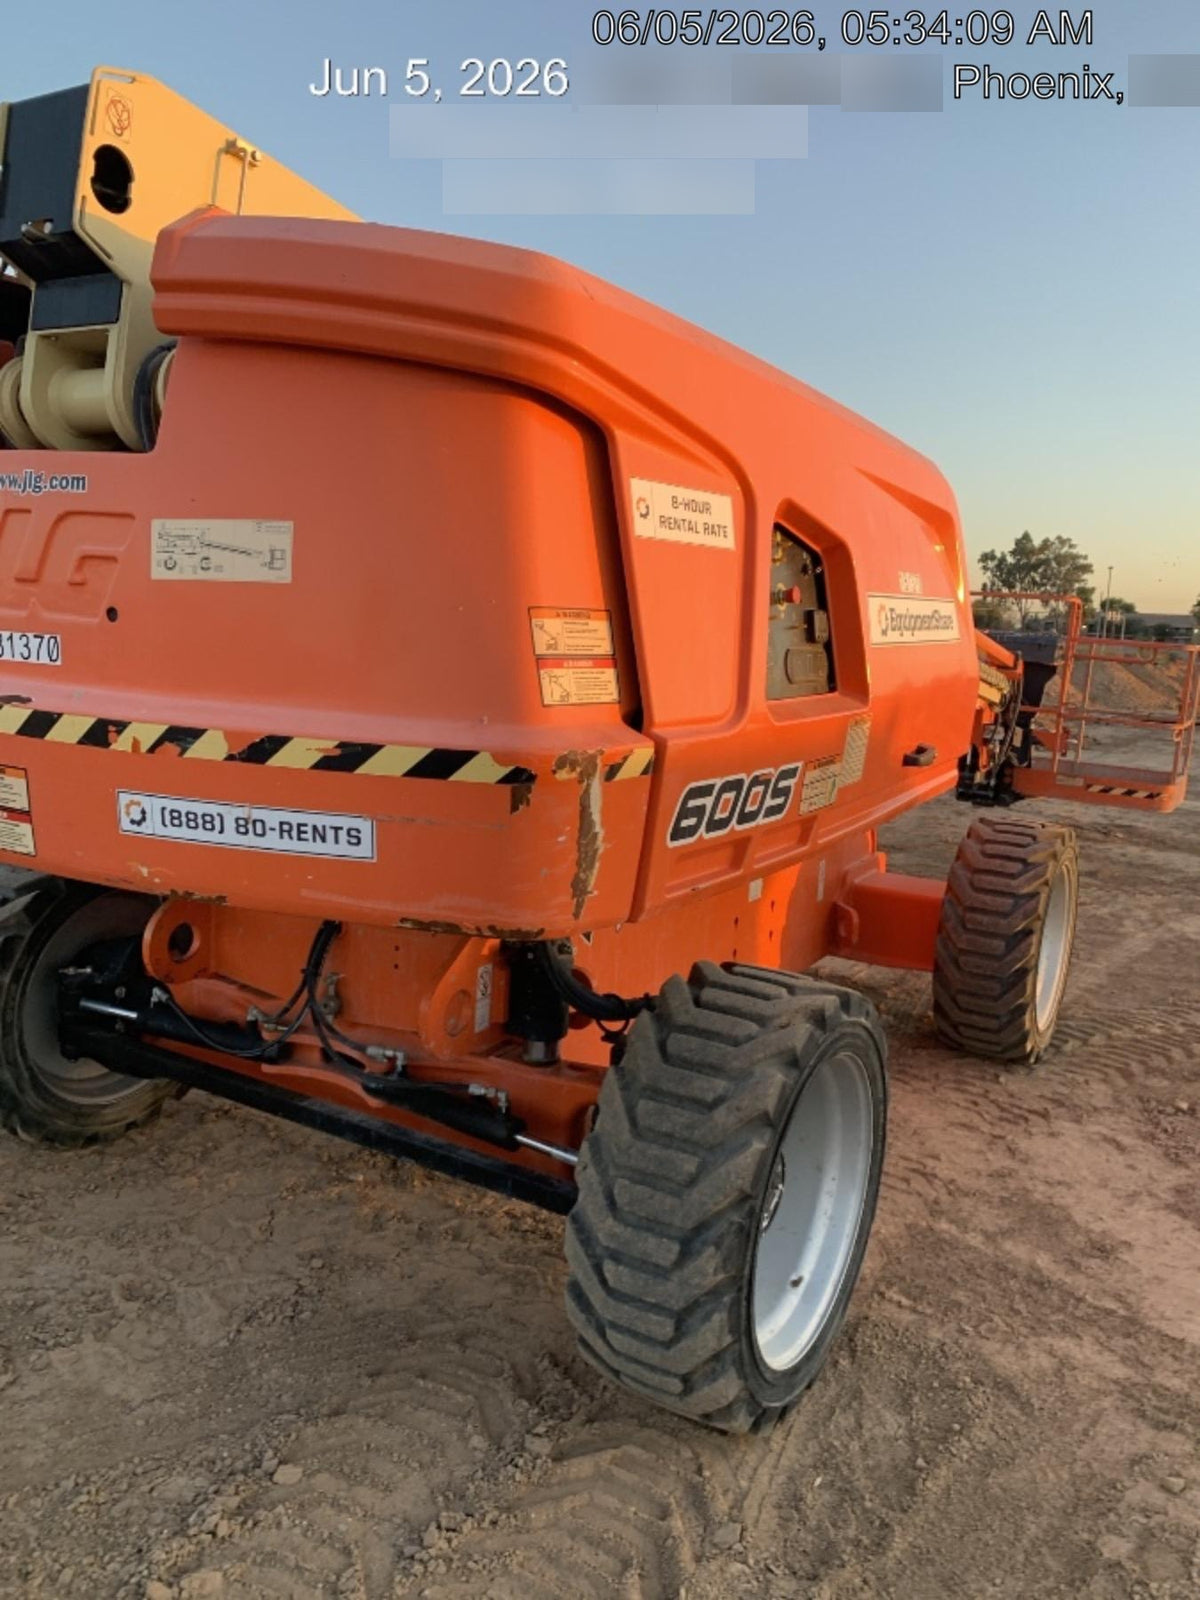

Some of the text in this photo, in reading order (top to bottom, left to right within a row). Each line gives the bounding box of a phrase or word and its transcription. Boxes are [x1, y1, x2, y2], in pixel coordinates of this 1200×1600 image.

[671, 495, 712, 515] 8-HOUR
[659, 515, 729, 539] RENTAL RATE
[668, 763, 802, 845] 600S
[160, 805, 362, 847] (888) 80-RENTS
